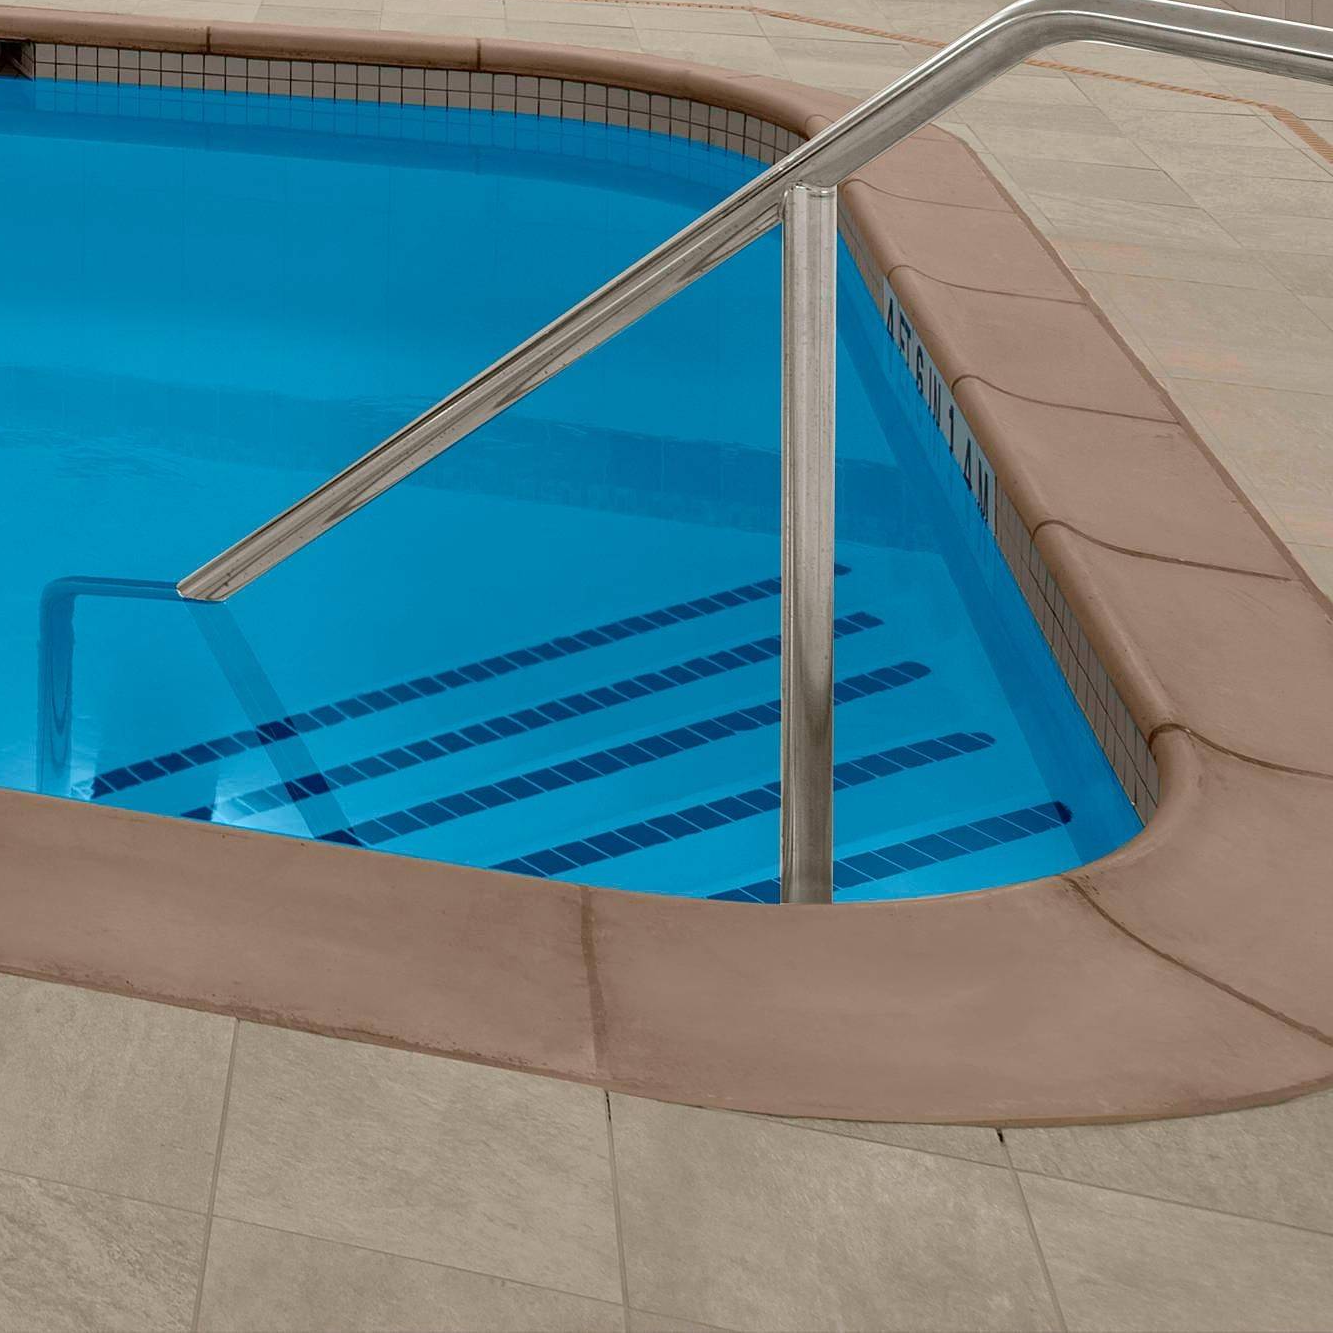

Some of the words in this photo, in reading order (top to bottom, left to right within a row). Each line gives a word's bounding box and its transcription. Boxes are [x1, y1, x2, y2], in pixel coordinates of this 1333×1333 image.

[887, 297, 895, 340] 4
[899, 312, 912, 368] FT
[916, 344, 924, 396] 6
[928, 367, 941, 428] IN
[948, 404, 954, 455] 1
[976, 458, 989, 523] M
